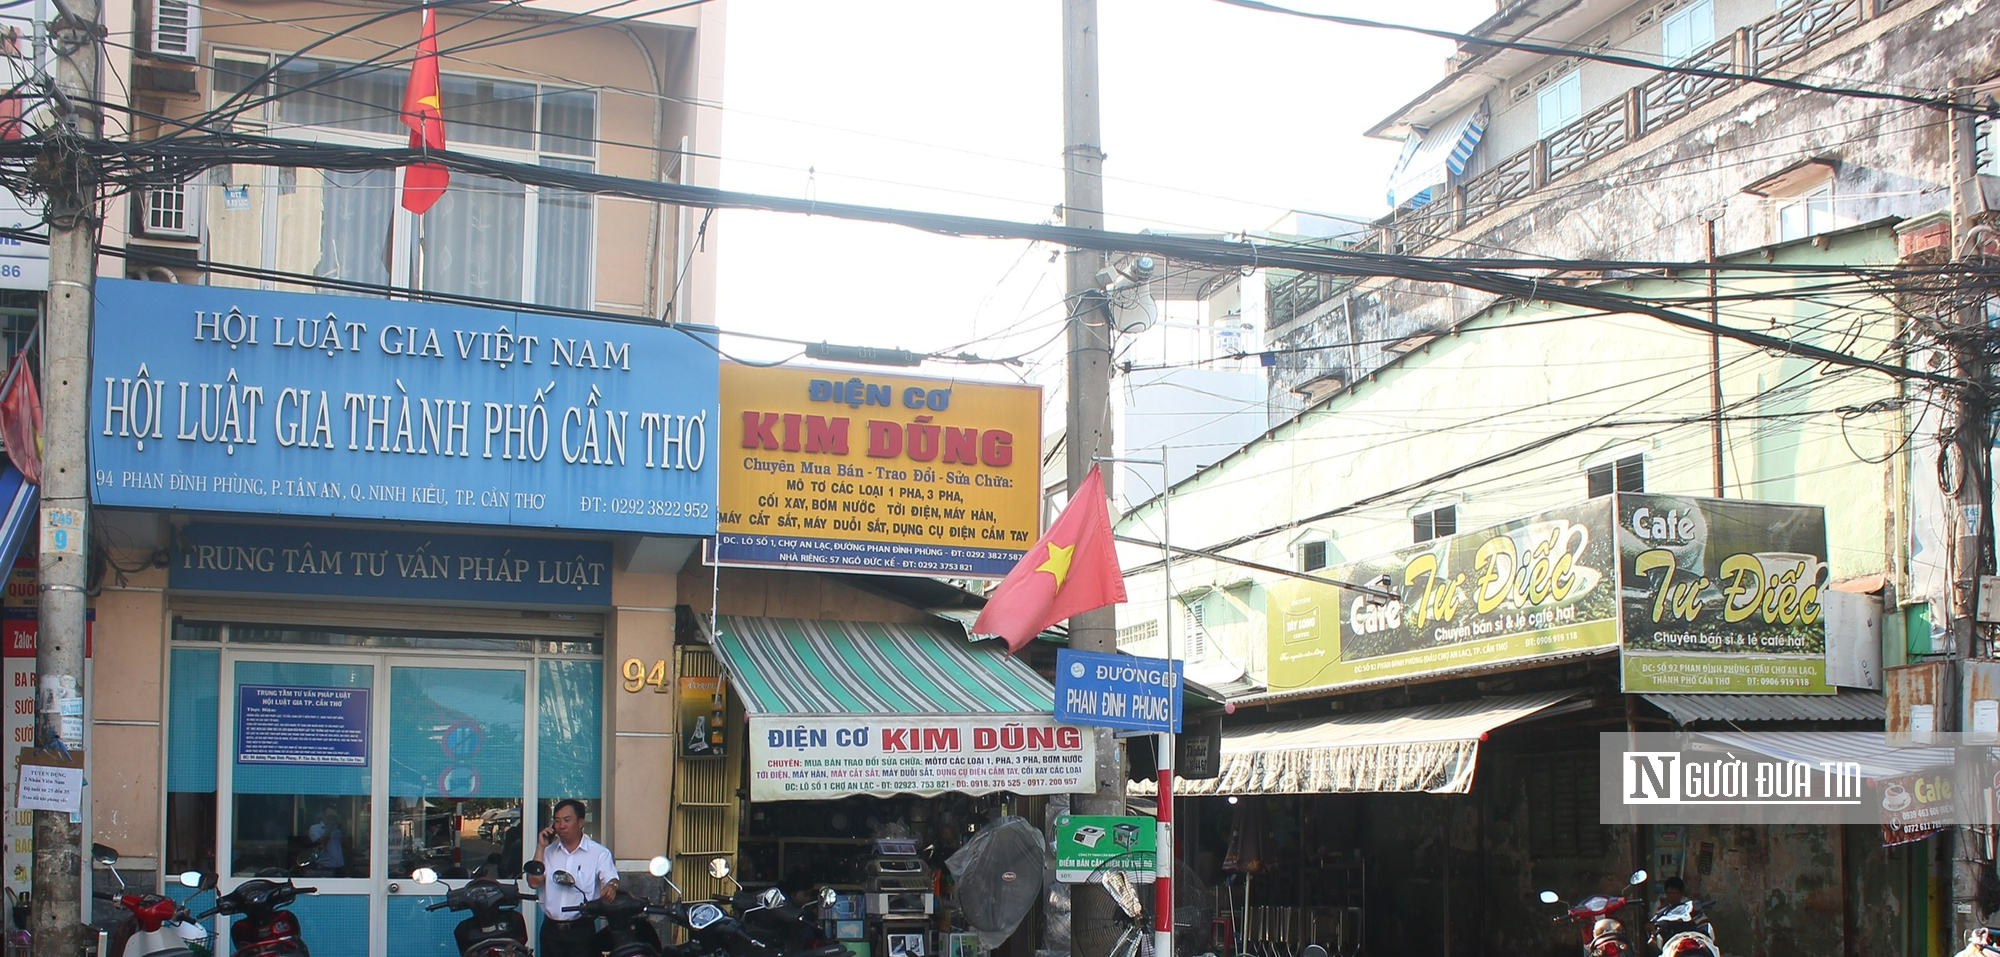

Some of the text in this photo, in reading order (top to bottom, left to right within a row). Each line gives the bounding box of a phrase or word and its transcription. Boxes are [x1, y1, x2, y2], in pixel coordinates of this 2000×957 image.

[194, 305, 631, 371] HỘI LUẬT GIA VIỆT NAM
[808, 377, 952, 412] ĐIỆN CƠ
[103, 362, 706, 472] HỘI LUẬT GIA THÀNH PHỐ CẦN THƠ
[742, 410, 1013, 467] KIM DŨNG
[743, 457, 1013, 488] Chuyên Mua Bán Trao Đổi Sửa Chữa:
[786, 477, 963, 503] MÔ TƠ CÁC LOẠI 1 PHA, 3 PHA,
[96, 469, 709, 519] 94 PHAN ĐÌNH PHÙNG, P. TÂN AN, Q. NINH KIỀU, TP. CẦN THƠ ĐT: 0292 3822 952
[758, 491, 997, 524] CỐI XAY, BƠM NƯỚC TỜI ĐIỆN, MÁY HÀN,
[55, 529, 67, 550] 9
[718, 510, 1029, 542] MÁY CẮT SẮT, MÁY DUỖI SẮT, DỤNG CỤ ĐIỆN CẦM TAY
[1632, 507, 1694, 540] Café
[183, 540, 605, 591] TRUNG TÂM TƯ VẤN PHÁP LUẬT
[1405, 529, 1577, 629] Tư Điếc
[1635, 549, 1821, 625] Tư Điếc
[622, 658, 669, 693] 94
[1096, 663, 1161, 685] ĐƯỜNG
[1067, 686, 1169, 722] PHAN ĐÌNH PHÙNG
[768, 722, 1083, 752] ĐIỆN CƠ KIM DŨNG
[1914, 775, 1952, 804] Café
